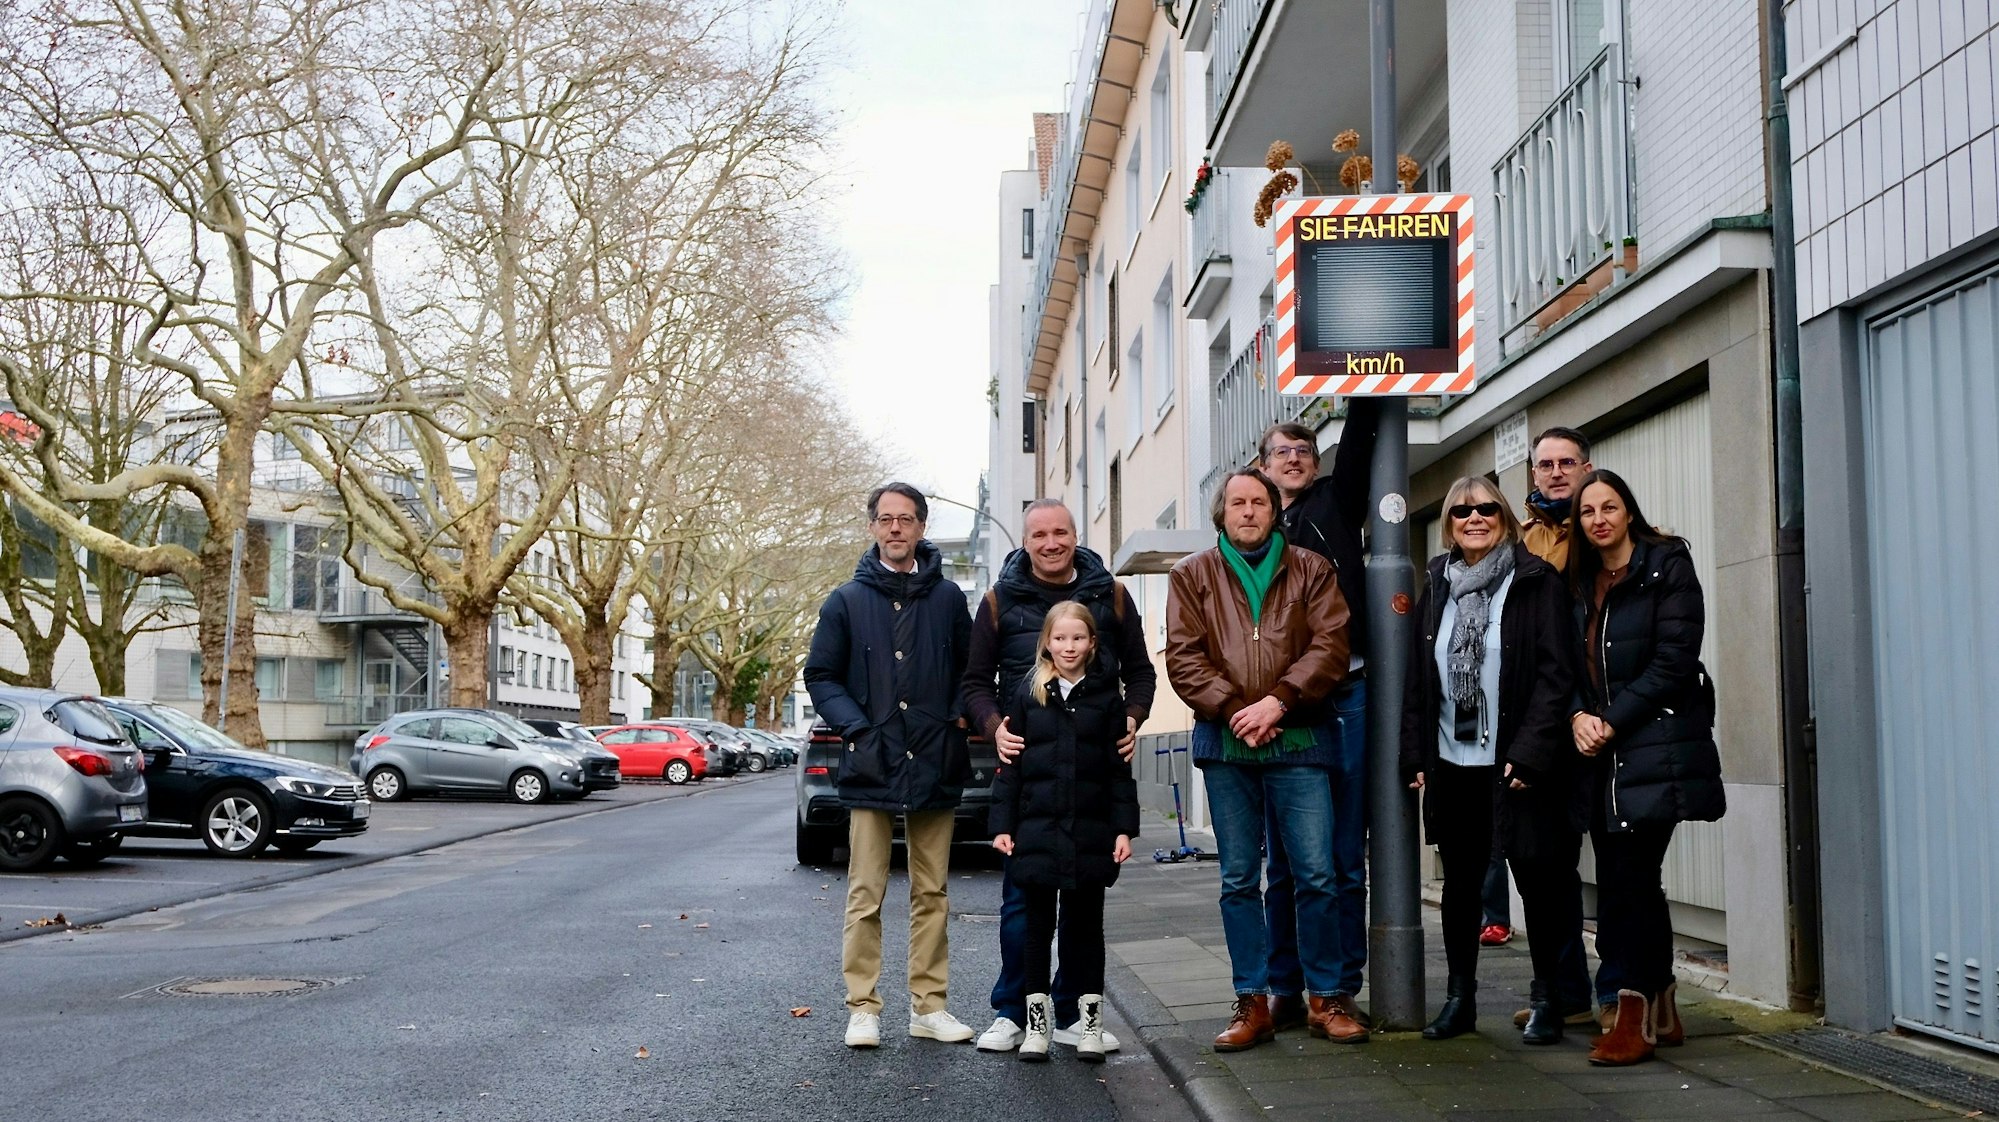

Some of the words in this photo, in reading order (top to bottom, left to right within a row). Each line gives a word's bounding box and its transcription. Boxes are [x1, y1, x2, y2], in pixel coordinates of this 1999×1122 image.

[1300, 217, 1338, 241] SIE
[1343, 213, 1450, 239] FAHREN
[1346, 352, 1405, 375] km/h
